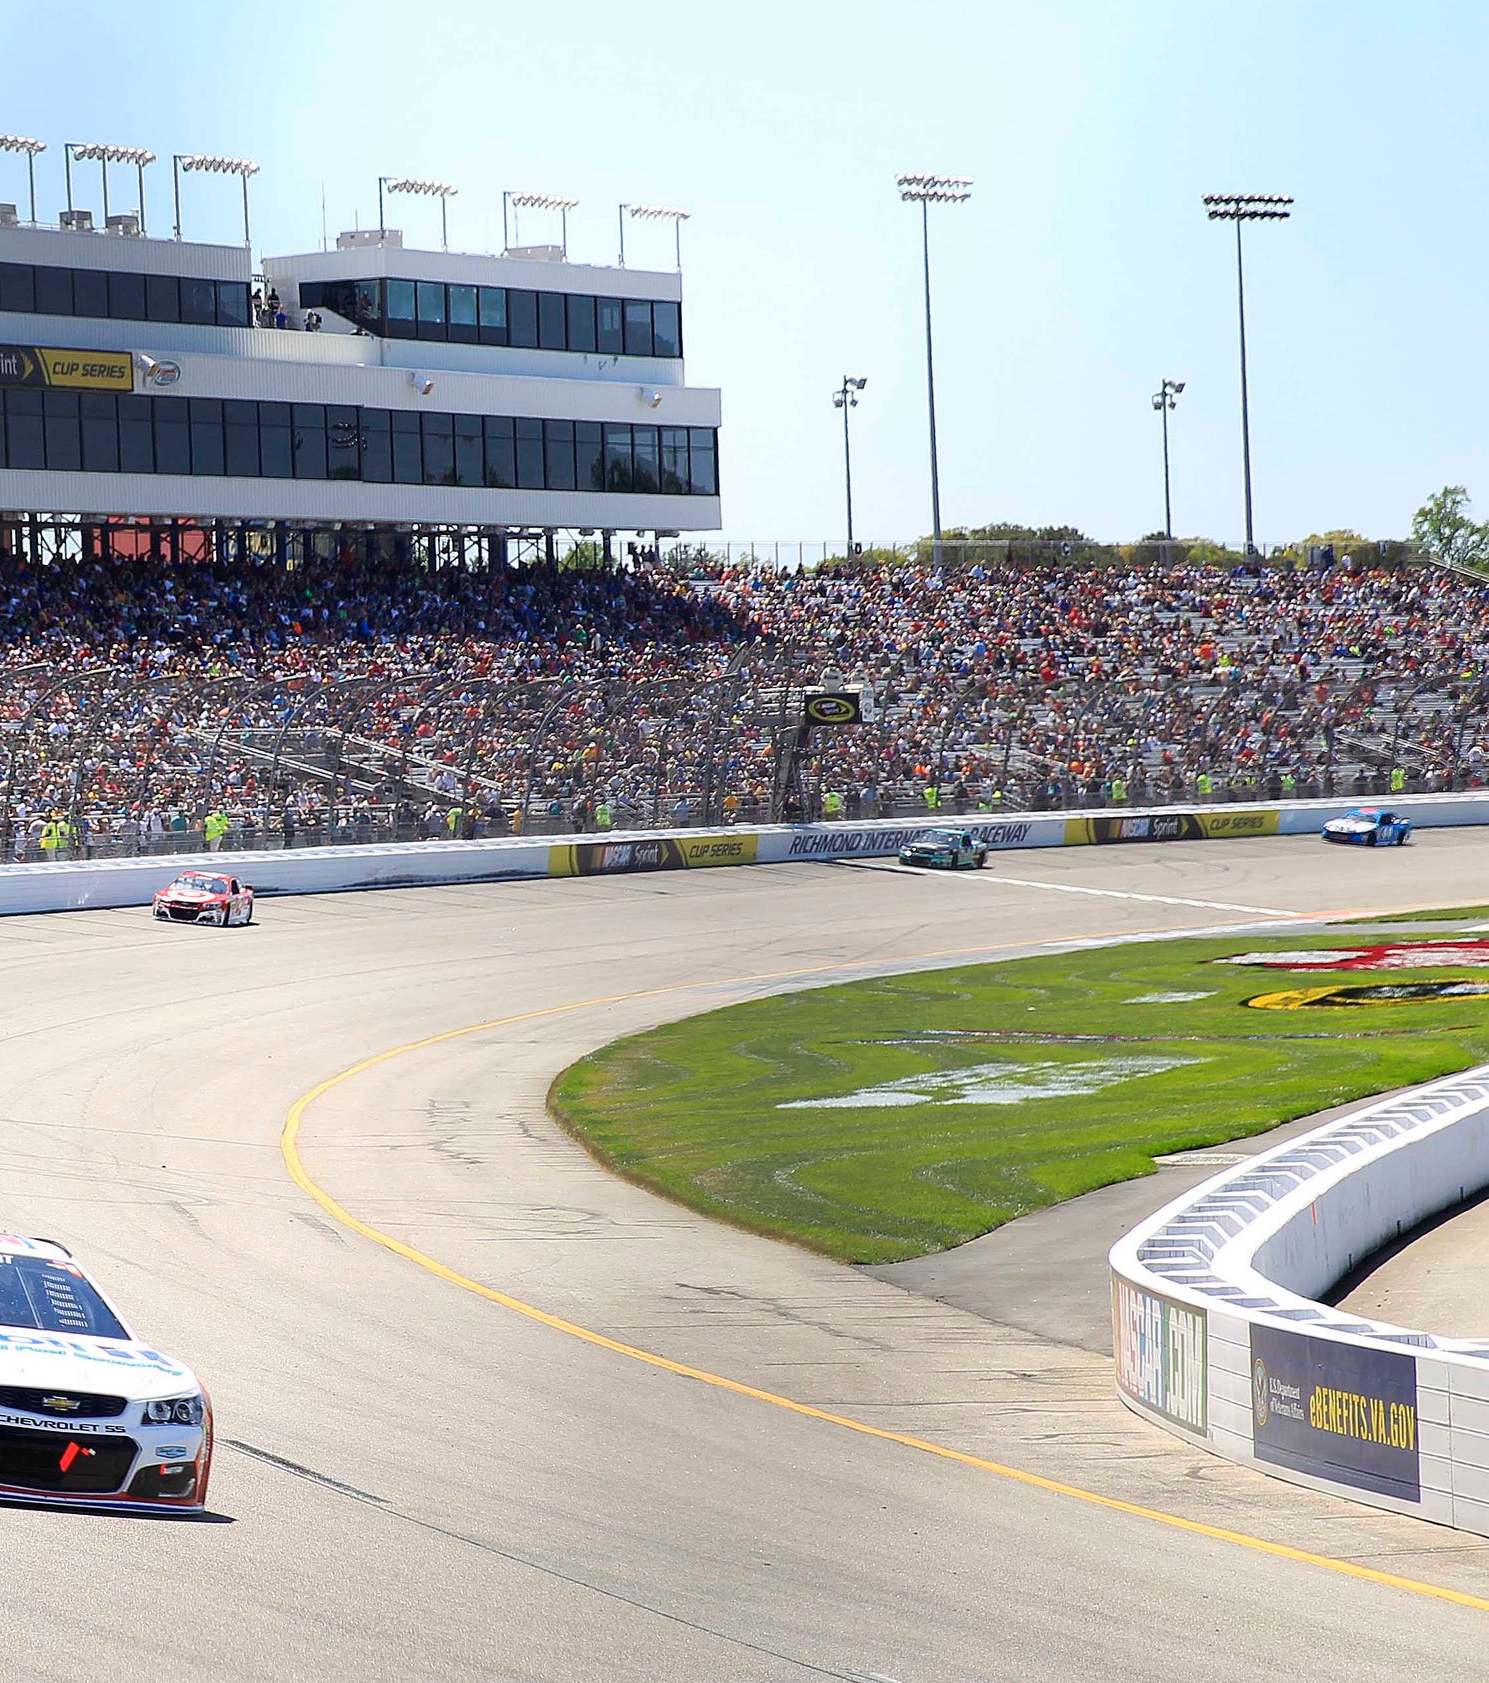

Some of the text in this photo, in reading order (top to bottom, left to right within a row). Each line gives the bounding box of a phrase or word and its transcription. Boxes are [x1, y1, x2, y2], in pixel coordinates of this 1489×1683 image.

[52, 361, 79, 377] CUP
[81, 363, 127, 378] SERIES
[1153, 818, 1179, 840] Sprint
[1210, 820, 1229, 830] CUP
[1231, 818, 1264, 829] SERIES
[634, 845, 659, 867] Sprint
[689, 846, 709, 858] CUP
[711, 842, 744, 857] SERIES
[789, 834, 860, 854] RICHMOND
[104, 1425, 126, 1433] SS
[1310, 1386, 1415, 1451] eBENEFITS.VA.GOV
